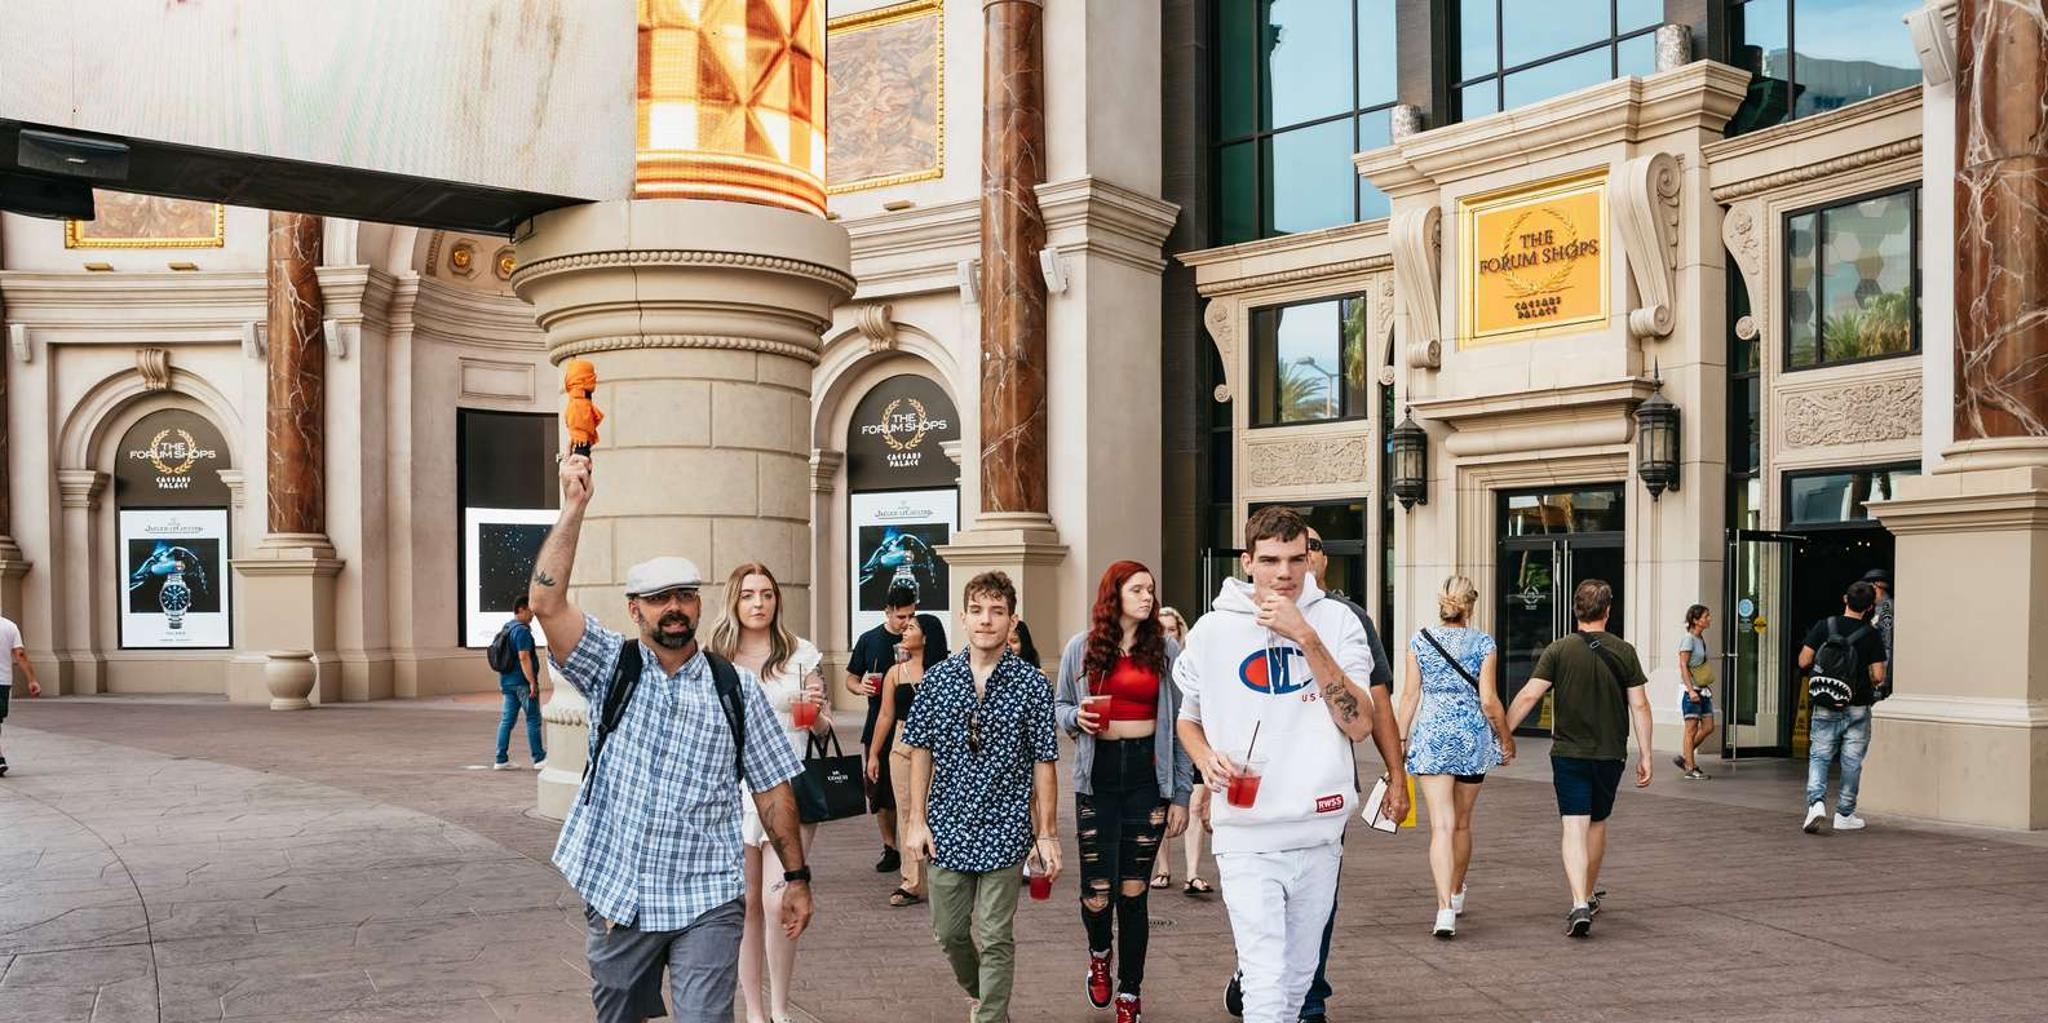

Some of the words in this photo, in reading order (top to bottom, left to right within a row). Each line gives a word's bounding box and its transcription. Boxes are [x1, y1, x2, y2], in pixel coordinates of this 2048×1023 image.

[1520, 229, 1553, 248] THE
[1480, 251, 1537, 274] FORUM
[1542, 239, 1599, 264] SHOPS
[1515, 296, 1562, 311] CAESARS
[1517, 306, 1558, 319] PALACE
[893, 412, 917, 423] THE
[862, 423, 904, 435] FORUM
[905, 419, 947, 432] SHOPS
[161, 442, 185, 451] THE
[130, 450, 172, 459] FORUM
[174, 450, 216, 459] SHOPS
[886, 452, 922, 461] CAESARS
[889, 459, 919, 468] PALACE
